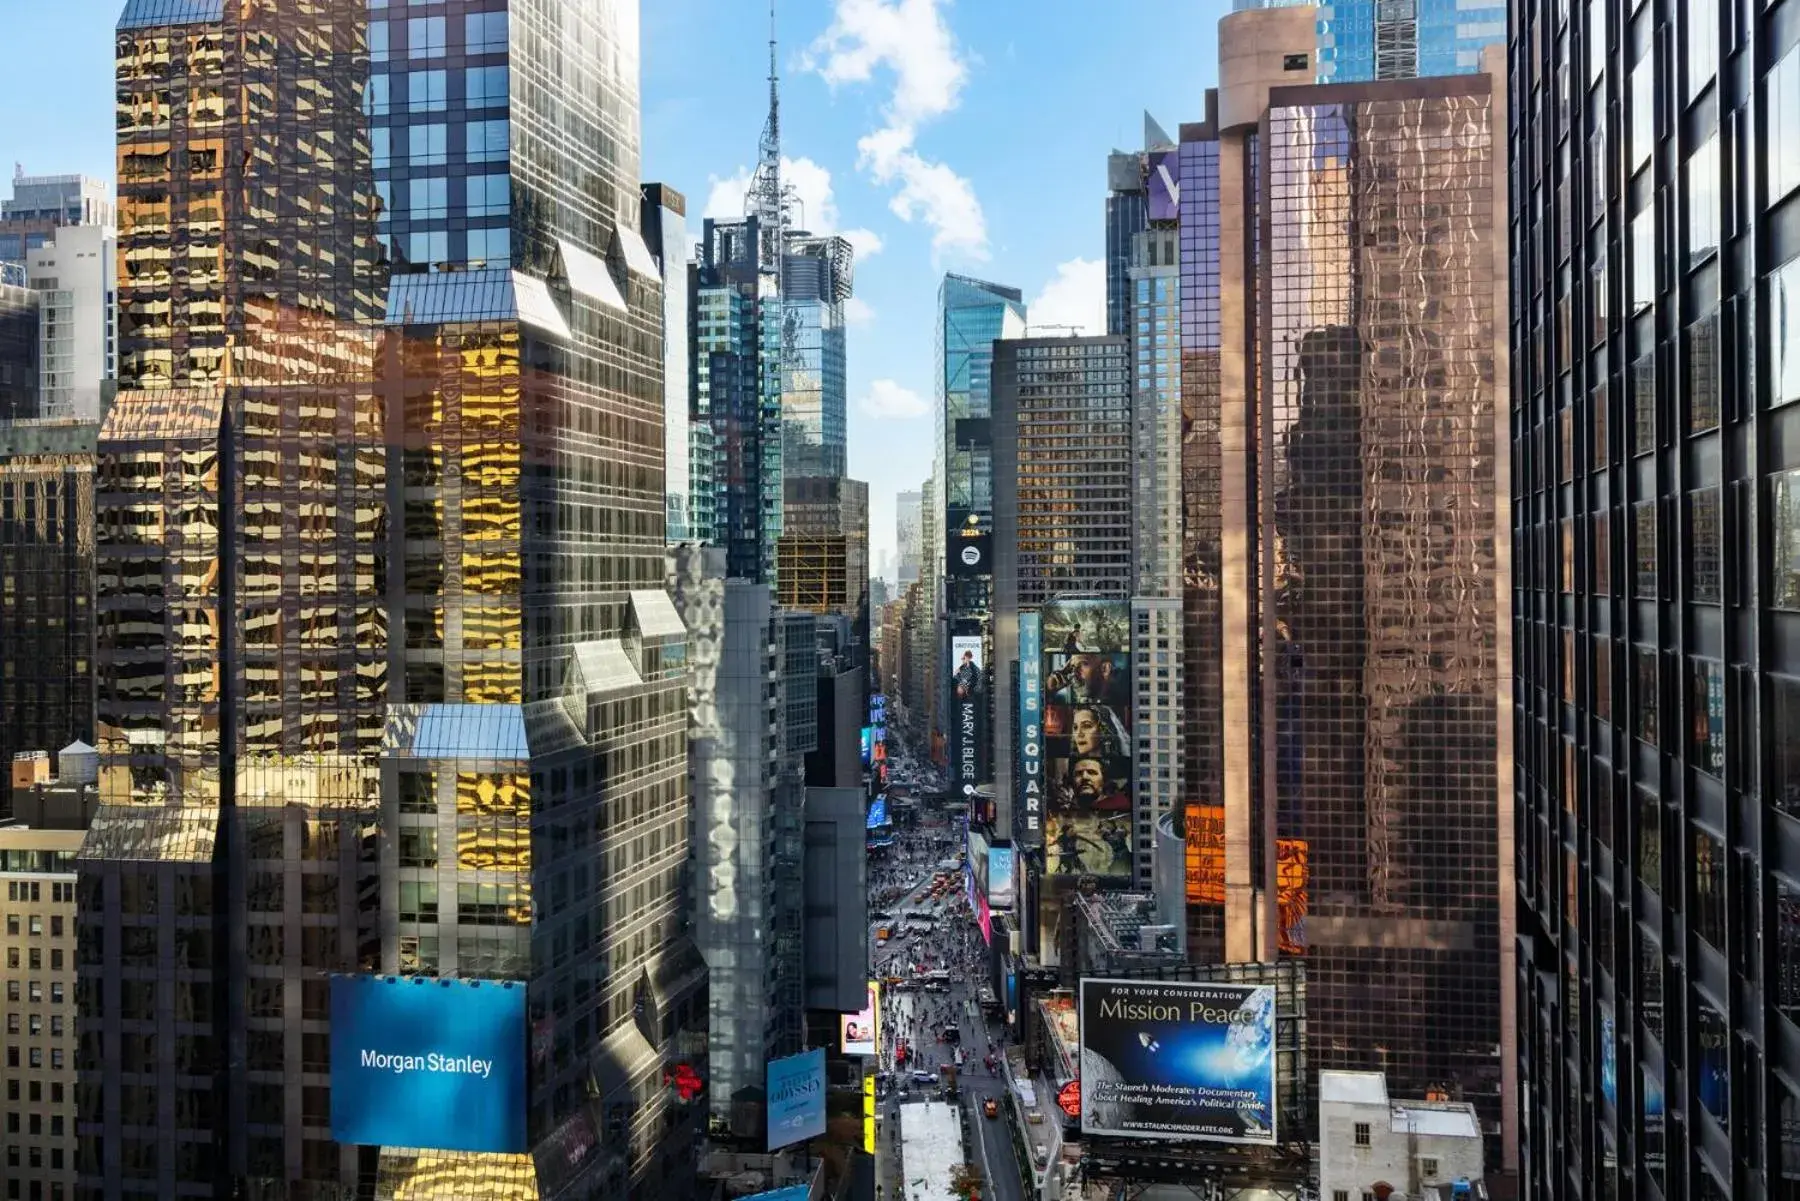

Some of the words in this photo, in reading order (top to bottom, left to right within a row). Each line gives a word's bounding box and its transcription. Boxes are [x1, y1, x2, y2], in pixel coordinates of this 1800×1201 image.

[1024, 625, 1038, 710] TIMES
[962, 703, 974, 737] MARY
[1025, 725, 1039, 830] SQUARE
[1111, 988, 1129, 996] FOR
[1134, 988, 1159, 997] YOUR
[1163, 990, 1242, 1000] CONSIDERATION
[1099, 998, 1180, 1022] Mission
[1190, 1001, 1254, 1026] Peace
[361, 1049, 425, 1074] Morgan
[427, 1053, 493, 1079] Stanley
[1093, 1092, 1118, 1102] About
[1120, 1094, 1153, 1106] Healing
[1155, 1096, 1198, 1107] America's
[1199, 1098, 1235, 1109] Political
[1236, 1101, 1266, 1111] Divide
[1097, 1081, 1113, 1090] The
[1151, 1084, 1196, 1096] Moderates
[1198, 1087, 1258, 1101] Documentary
